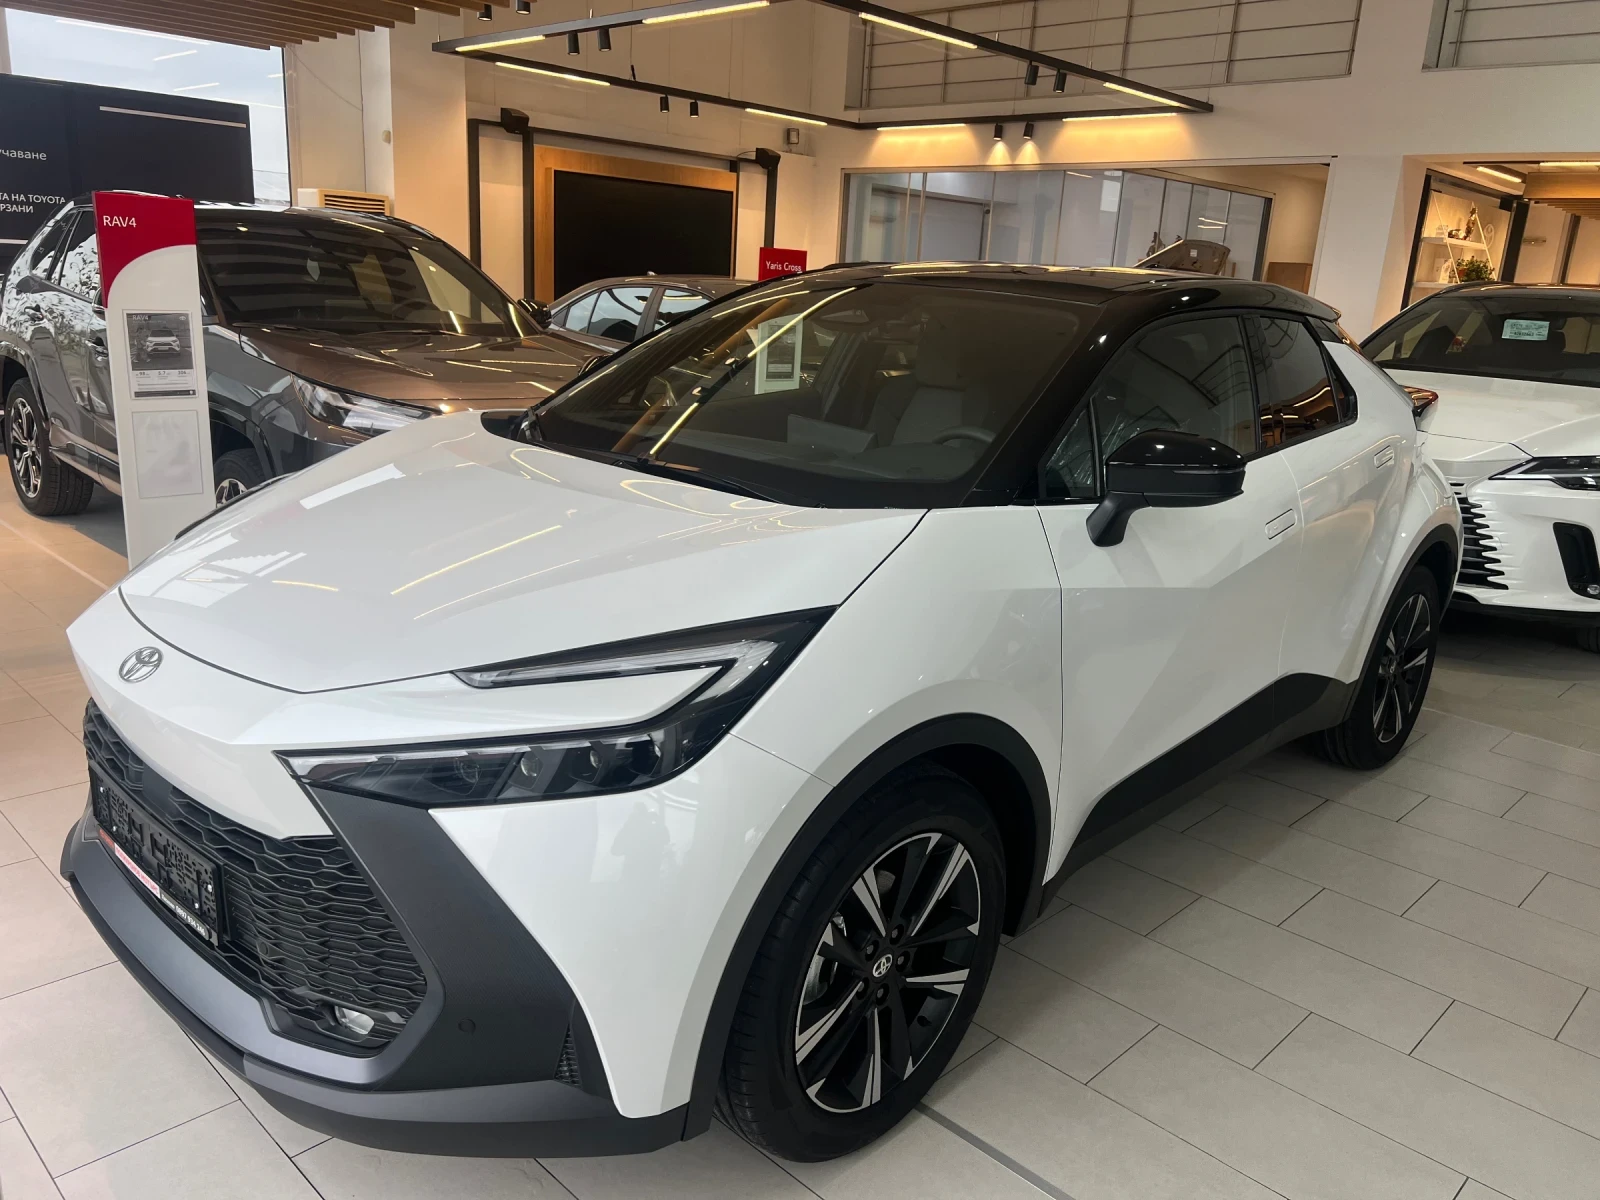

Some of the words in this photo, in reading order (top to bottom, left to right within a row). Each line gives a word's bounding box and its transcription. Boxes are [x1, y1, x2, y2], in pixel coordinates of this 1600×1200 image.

[11, 193, 27, 202] НА
[27, 194, 66, 204] TOYOTA
[103, 215, 137, 228] RAV4
[765, 260, 782, 270] Yaris
[783, 262, 802, 271] Cross
